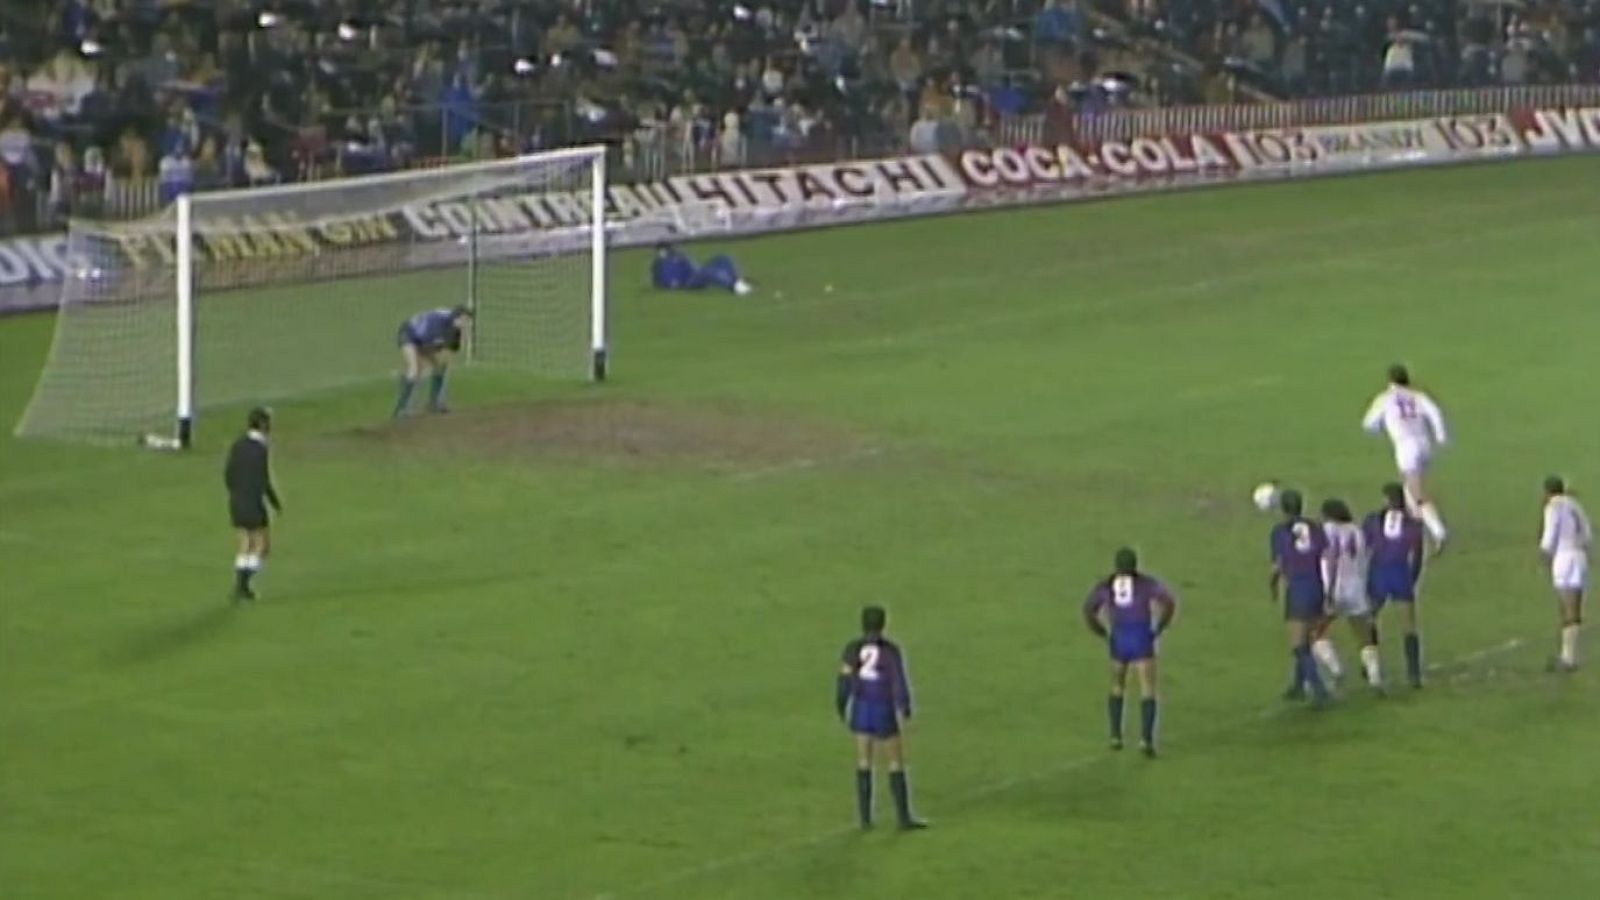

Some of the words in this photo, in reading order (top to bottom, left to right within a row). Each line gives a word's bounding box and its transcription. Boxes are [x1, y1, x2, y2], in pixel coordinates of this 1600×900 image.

[689, 158, 947, 208] HITACHI
[1292, 521, 1311, 552] 3
[859, 644, 880, 681] 2
